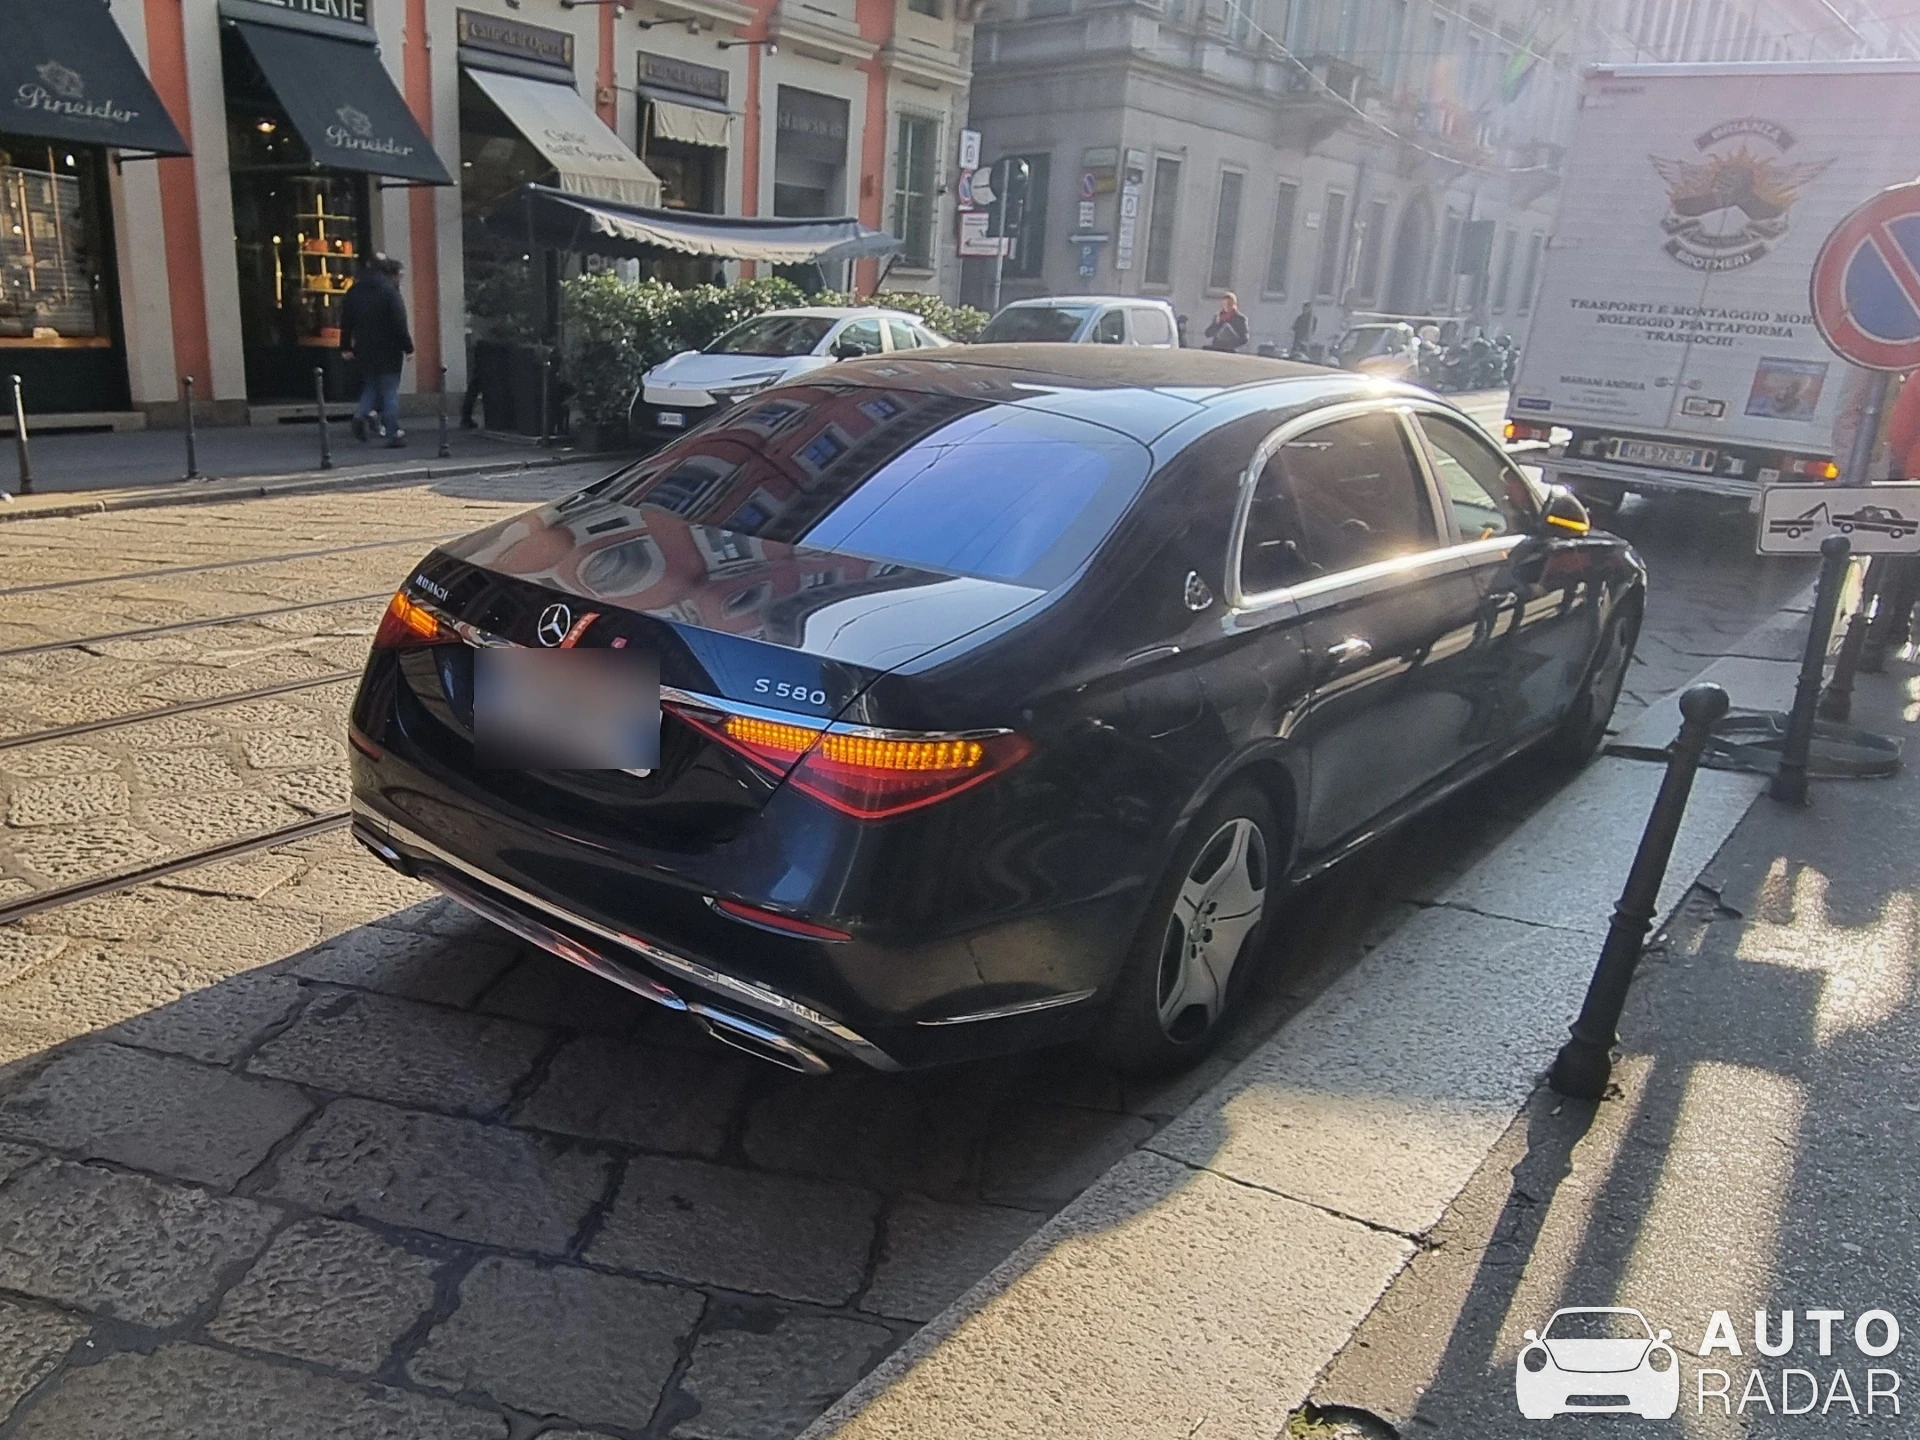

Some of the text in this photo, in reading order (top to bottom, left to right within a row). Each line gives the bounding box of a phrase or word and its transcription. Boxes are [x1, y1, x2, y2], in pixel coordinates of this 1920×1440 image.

[14, 83, 139, 122] Pineider
[325, 125, 413, 154] Pineider
[1570, 299, 1814, 325] TRASPORTI E MONTAGGIO MOB
[1597, 314, 1793, 338] NOLEGGIO PIATTAFORMA
[1646, 331, 1734, 346] TRASLOCHI
[754, 679, 826, 705] S 580
